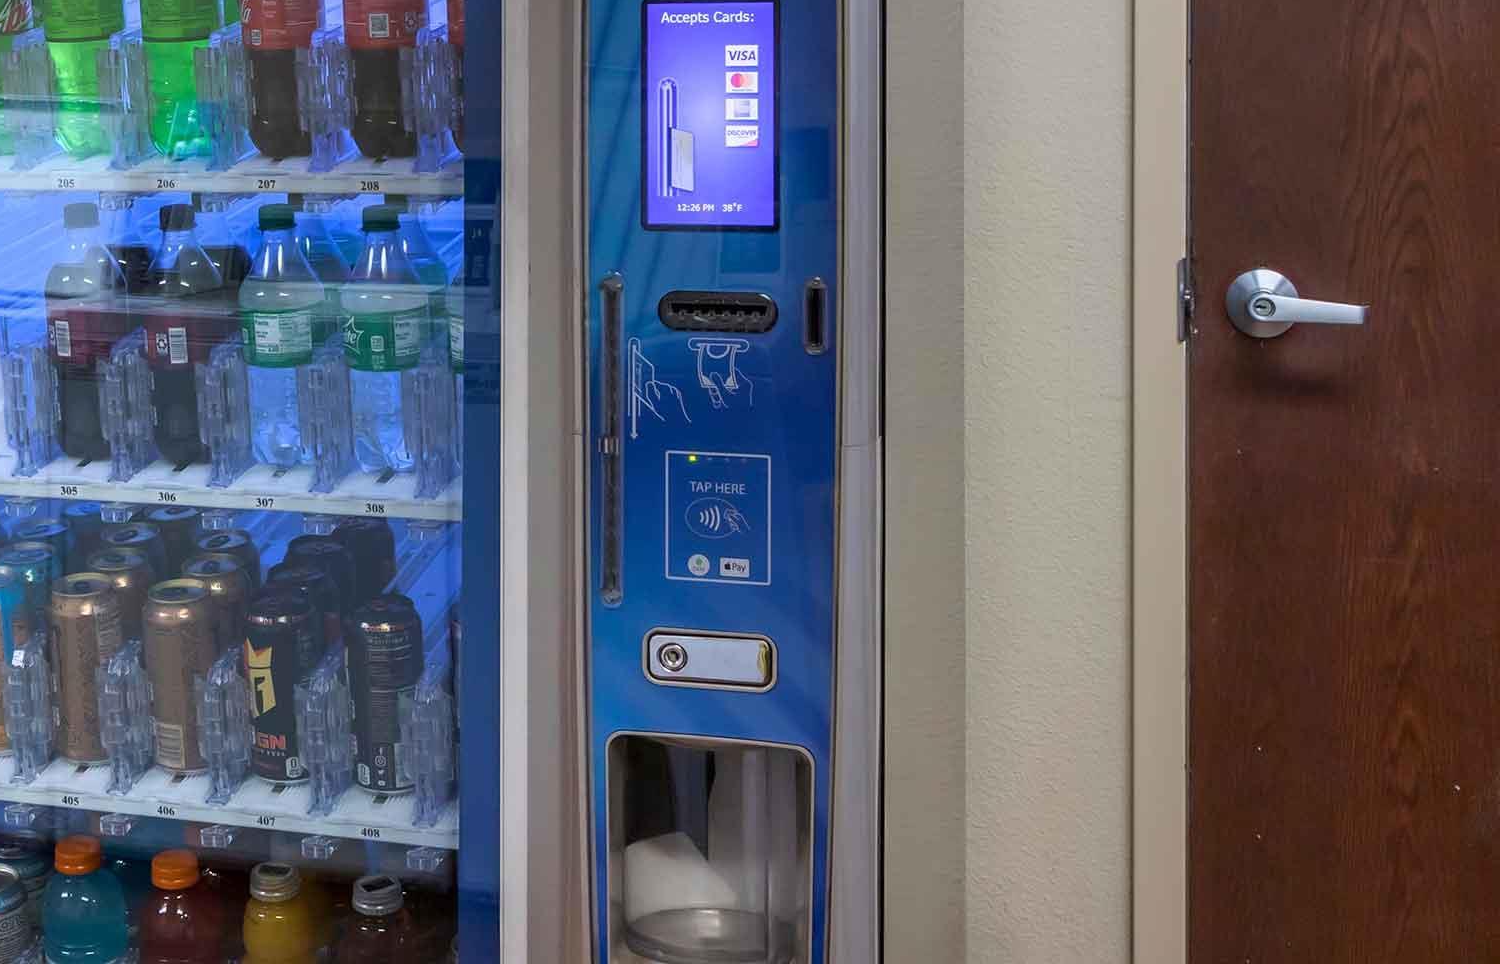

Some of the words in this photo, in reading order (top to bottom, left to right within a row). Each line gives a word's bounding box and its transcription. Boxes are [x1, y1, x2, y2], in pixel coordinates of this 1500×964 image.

[660, 11, 710, 26] Accepts
[713, 10, 754, 23] Cards:
[727, 50, 756, 61] VISA
[57, 178, 75, 188] 205
[157, 179, 175, 189] 206
[257, 179, 276, 189] 207
[360, 181, 380, 191] 208
[702, 203, 715, 212] PM
[60, 486, 78, 496] 305
[690, 481, 712, 492] TAP
[715, 483, 746, 494] HERE
[158, 492, 176, 502] 306
[256, 497, 275, 508] 307
[365, 503, 385, 514] 308
[731, 562, 747, 572] Pay
[62, 795, 80, 806] 405
[157, 805, 175, 816] 406
[256, 816, 275, 826] 407
[361, 827, 380, 838] 408
